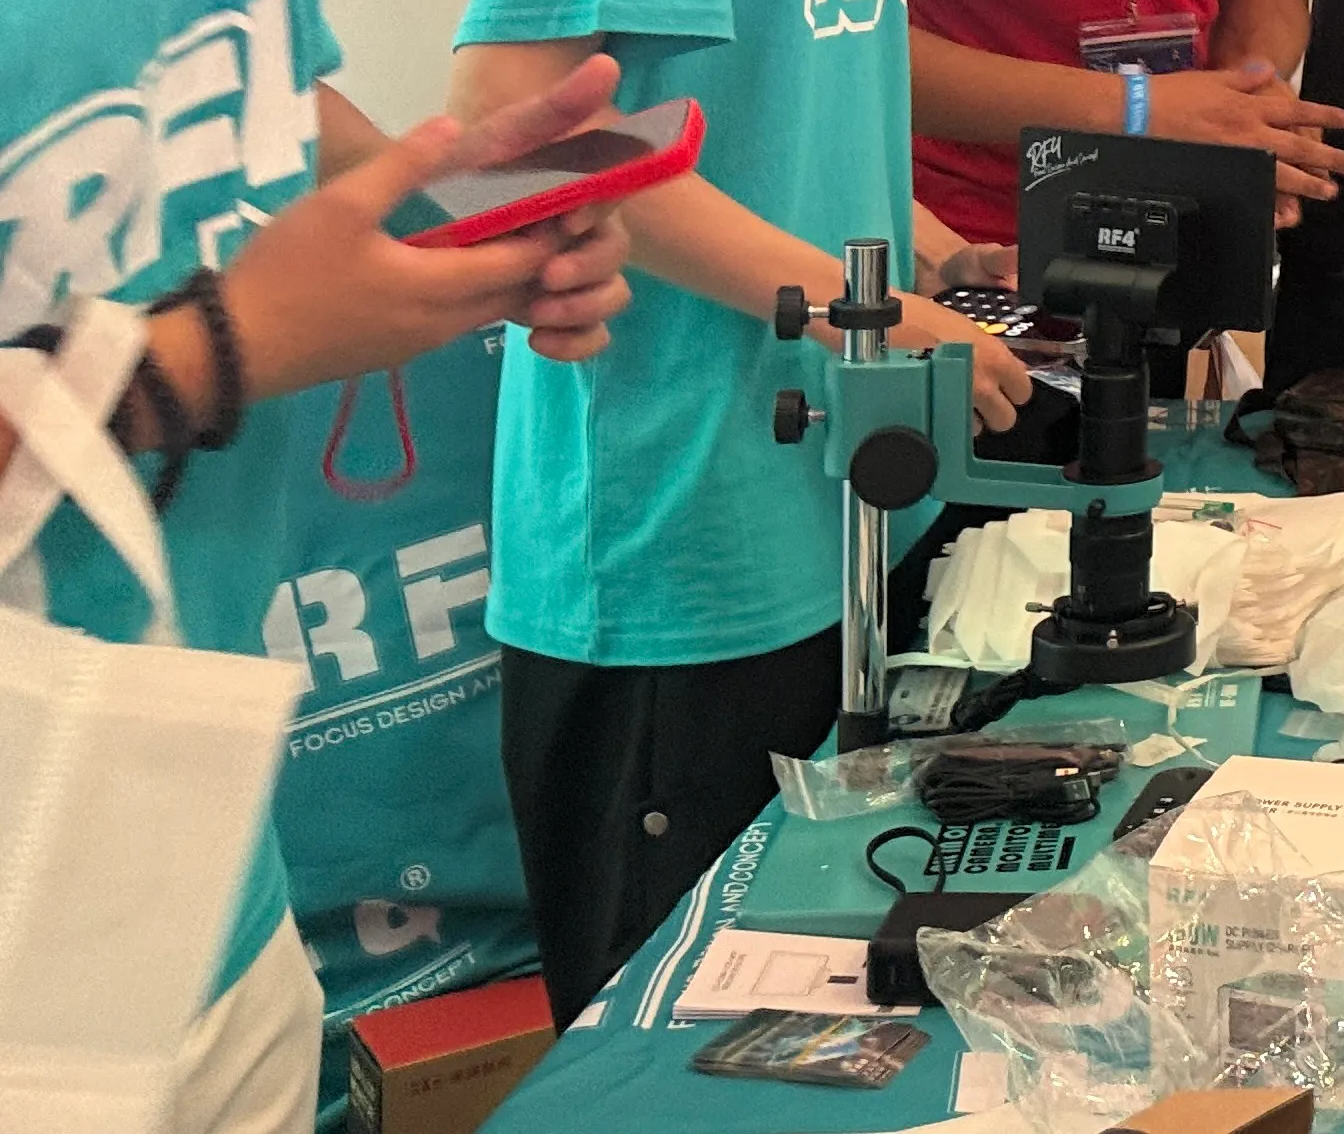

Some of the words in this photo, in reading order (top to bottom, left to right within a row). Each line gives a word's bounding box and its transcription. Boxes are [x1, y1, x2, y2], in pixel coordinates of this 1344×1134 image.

[1097, 226, 1136, 247] RF4
[288, 717, 375, 760] FOCUS
[376, 687, 466, 730] DESIGN
[471, 667, 503, 697] AN
[1293, 801, 1344, 812] SUPPLY
